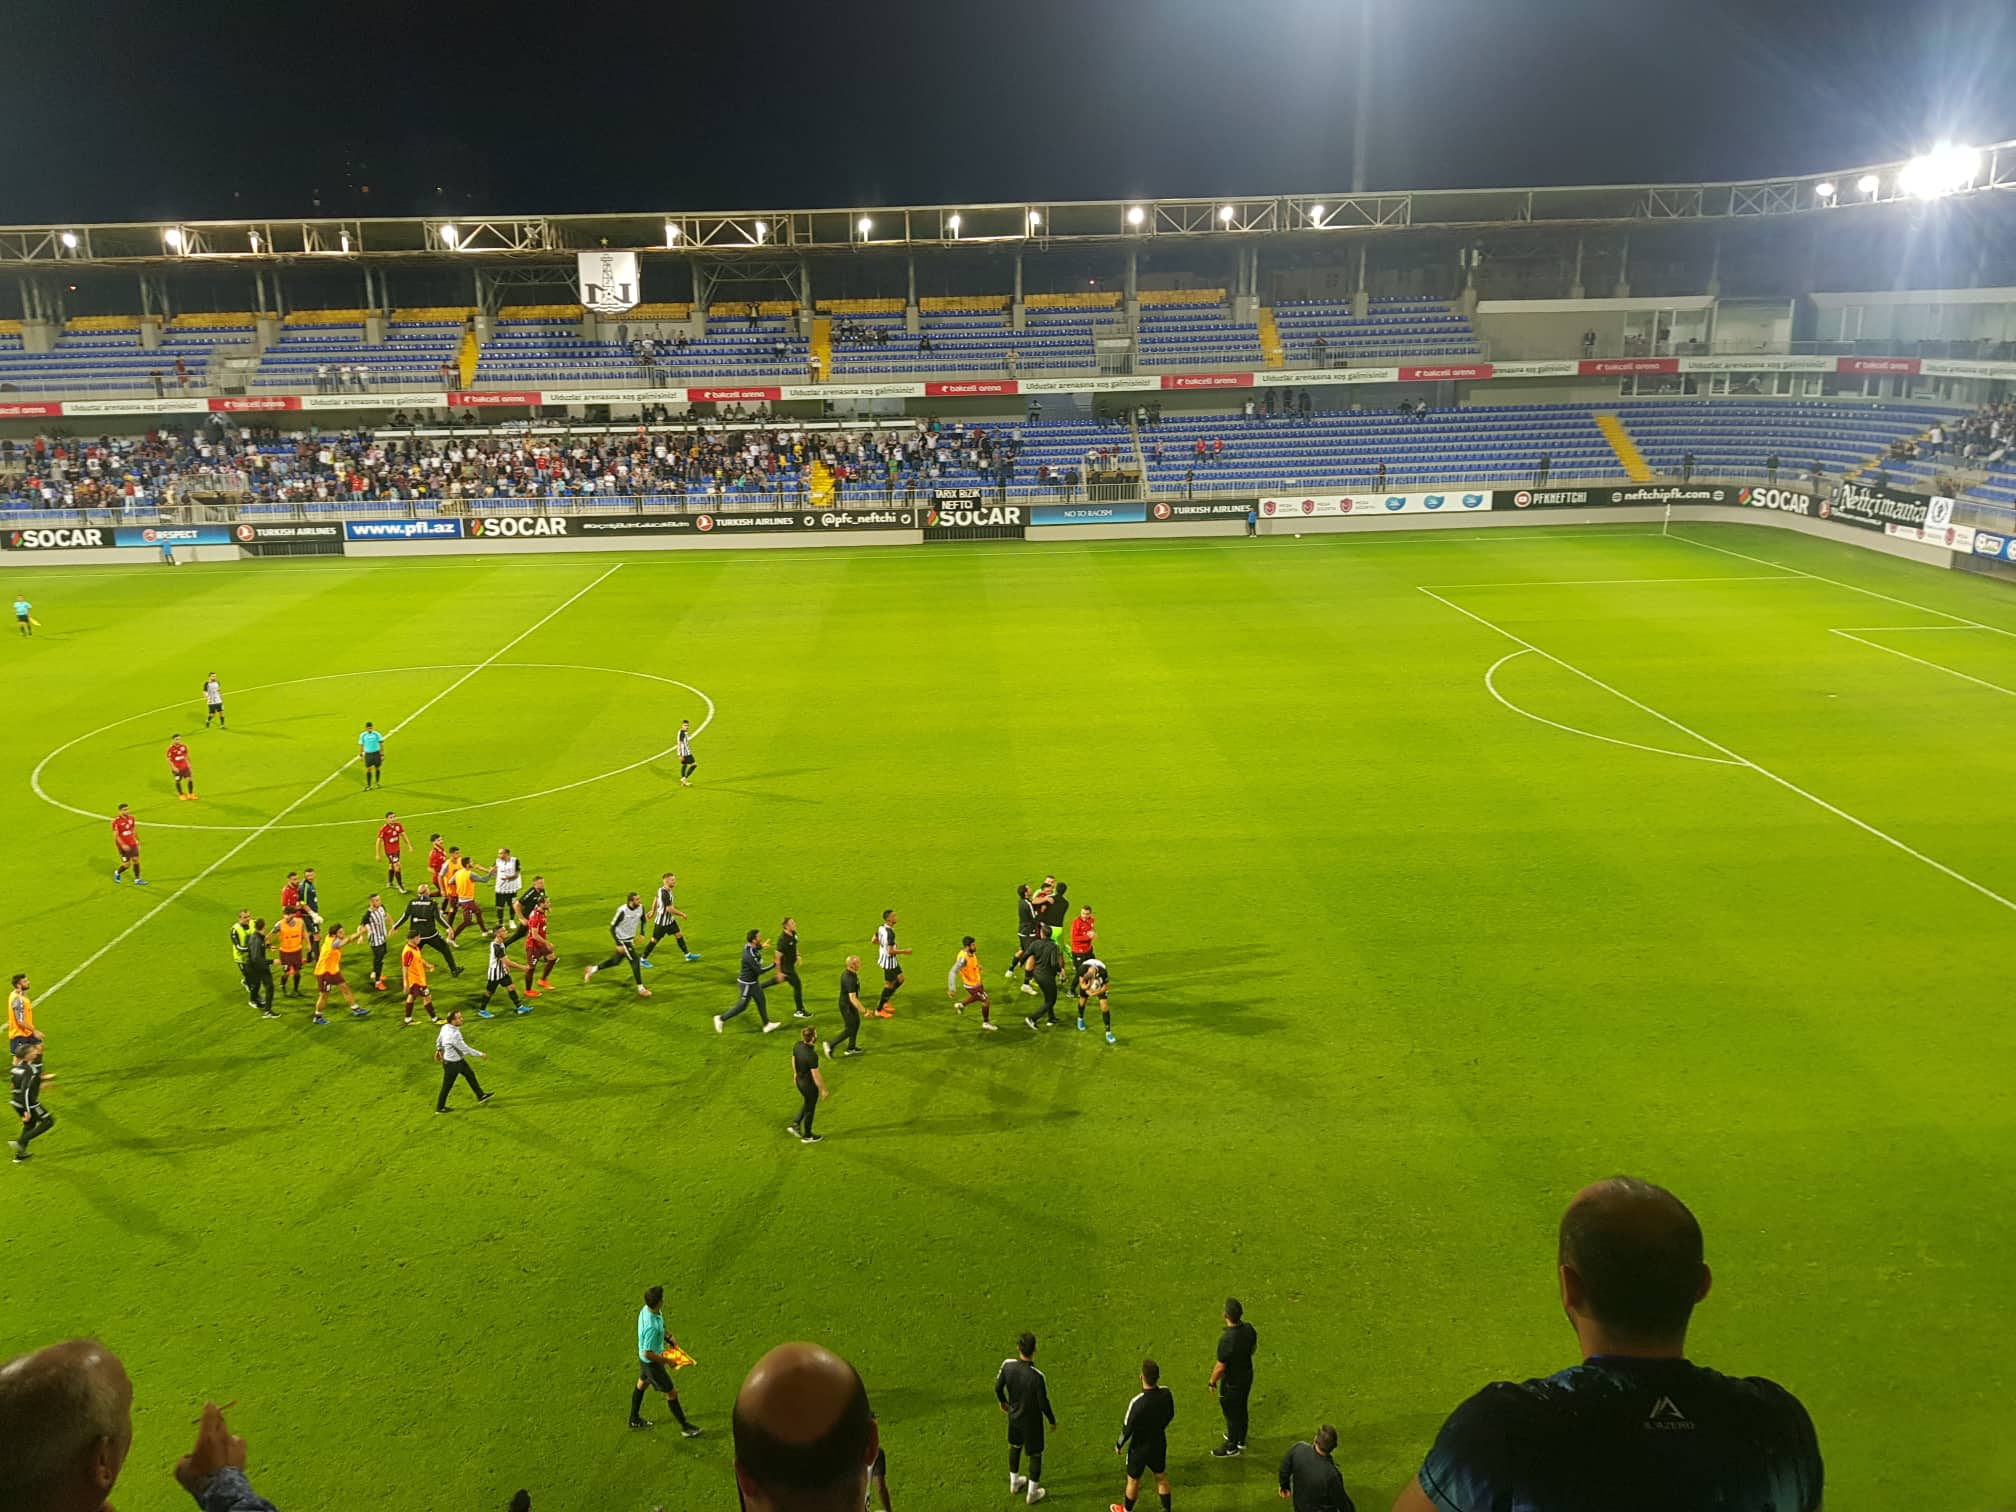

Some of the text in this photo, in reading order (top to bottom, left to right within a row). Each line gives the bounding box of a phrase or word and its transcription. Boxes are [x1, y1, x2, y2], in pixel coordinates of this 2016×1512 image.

[1624, 488, 1710, 502] neftchipfk.com
[1752, 488, 1809, 514] SOCAR
[940, 508, 1020, 525] SOCAR
[1064, 510, 1076, 518] NO
[1077, 510, 1087, 518] TO
[1173, 506, 1210, 515] TURKISH
[484, 518, 567, 536] SOCAR
[716, 517, 793, 526] TURKISH AIRLINES
[822, 513, 896, 527] @pfc_neftchi
[257, 527, 336, 536] TURKISH AIRLINES
[353, 522, 455, 536] www.pfl.az
[23, 529, 103, 547] SOCAR
